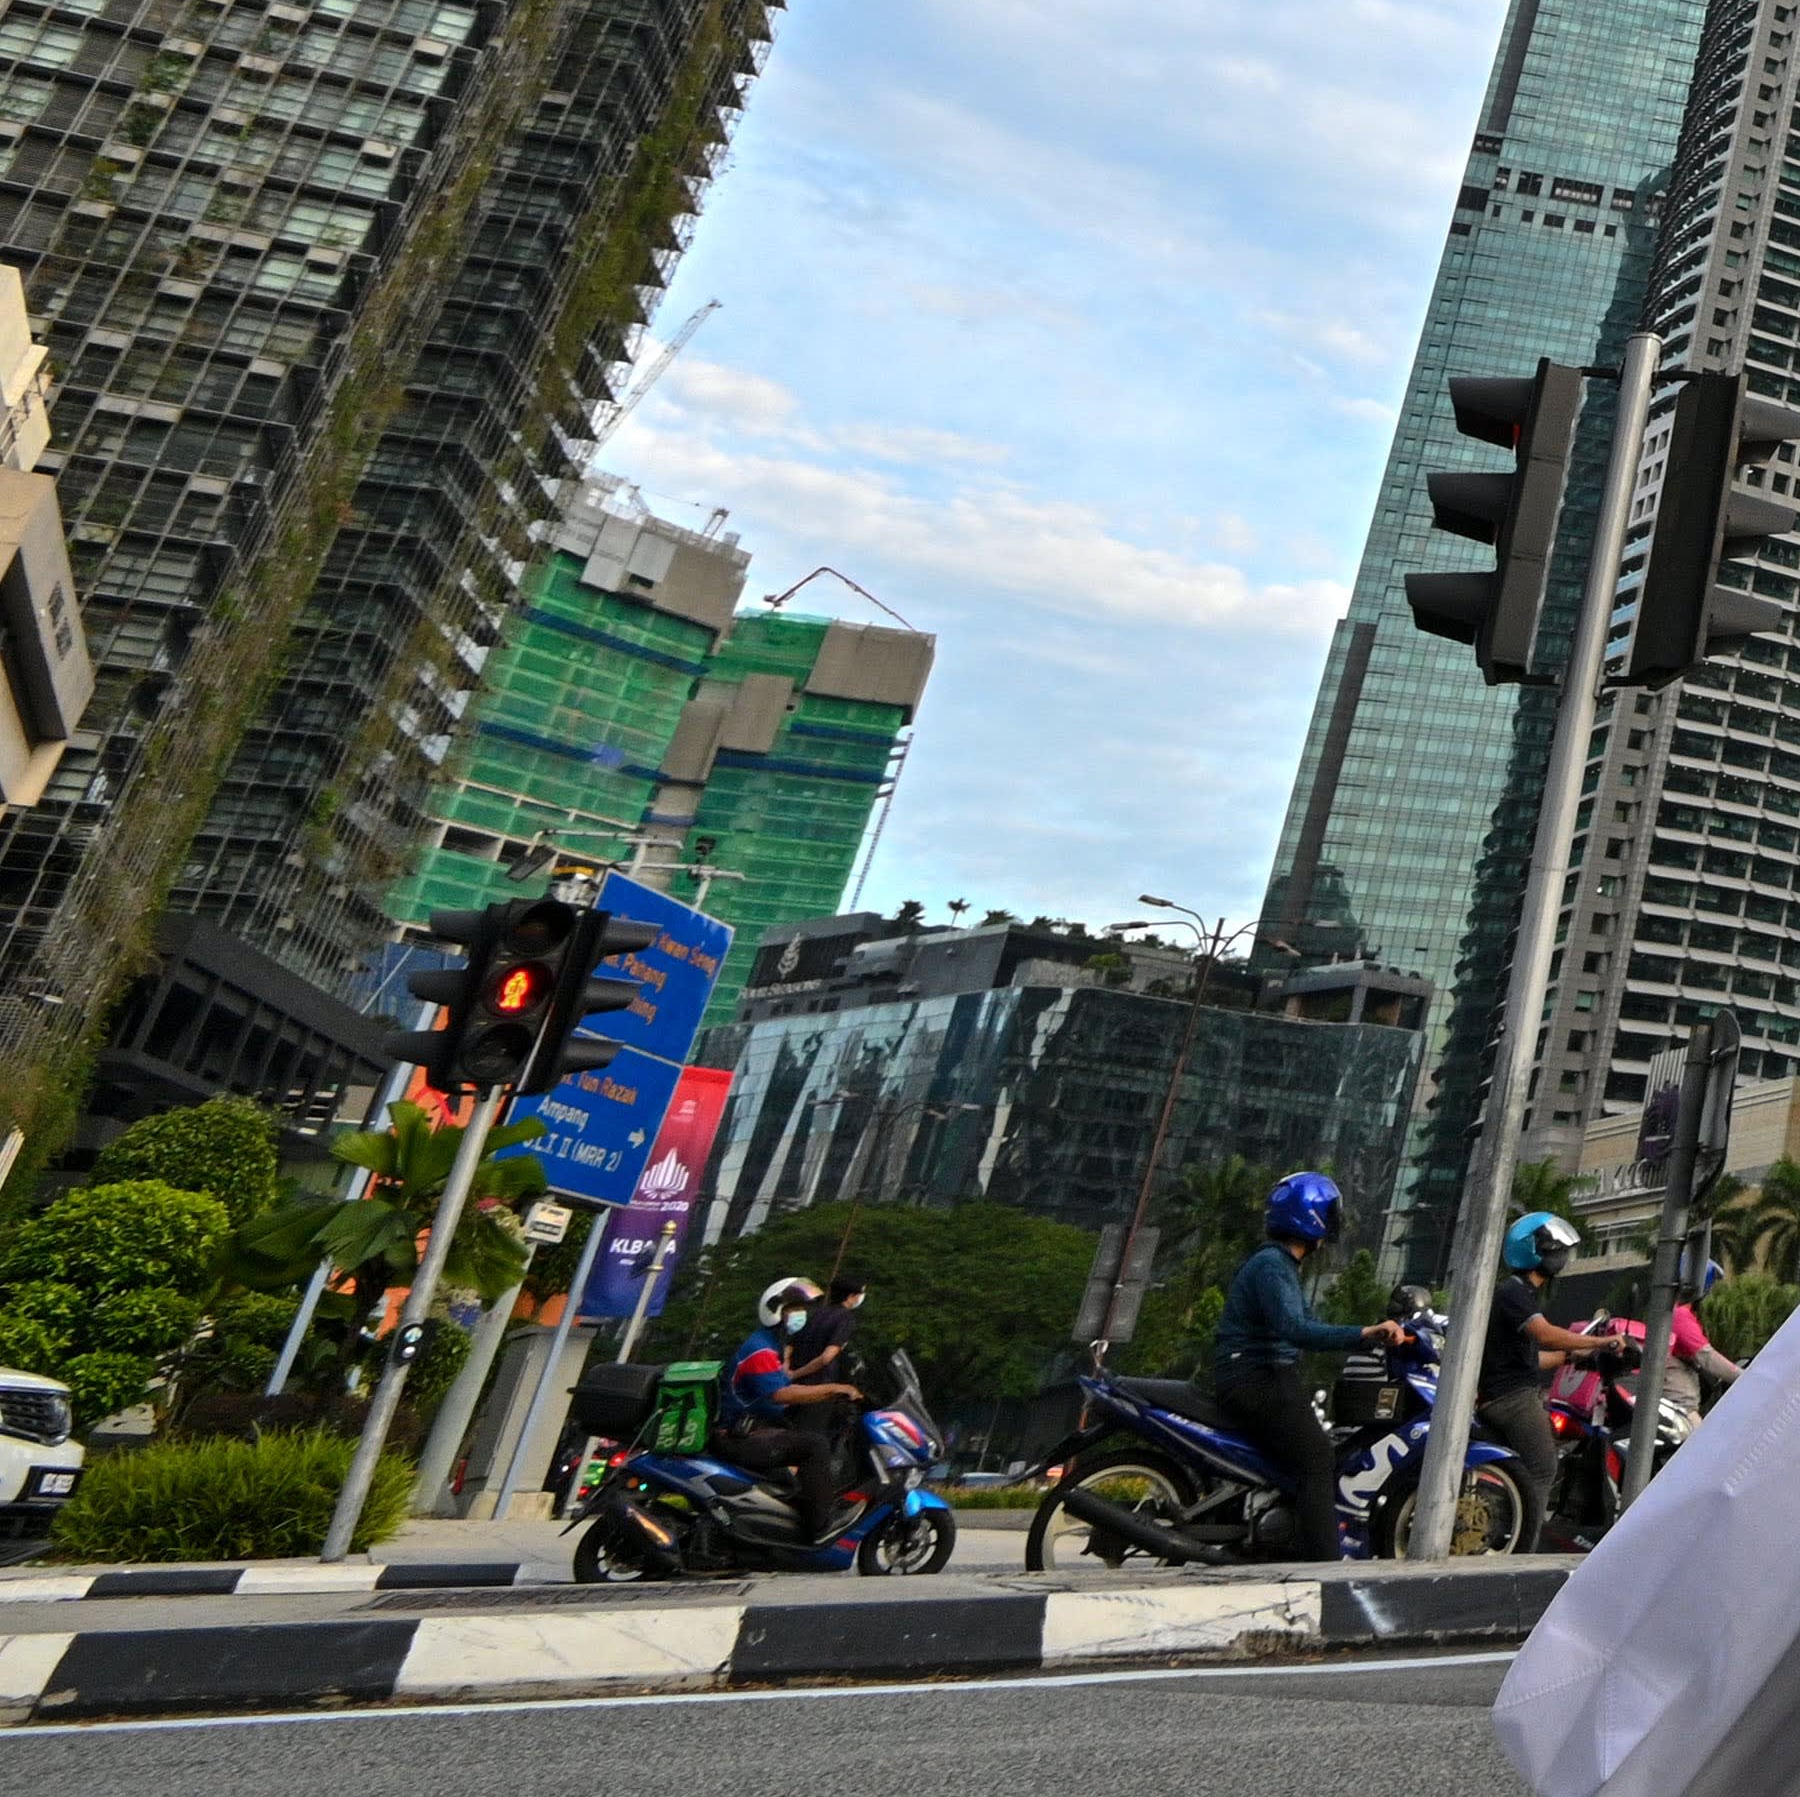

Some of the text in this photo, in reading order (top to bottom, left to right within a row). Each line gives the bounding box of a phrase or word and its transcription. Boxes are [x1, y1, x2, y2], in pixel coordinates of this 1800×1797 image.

[622, 953, 667, 993] Pahang
[689, 946, 717, 978] Seng
[578, 1071, 600, 1093] Tun
[601, 1076, 637, 1106] Razak
[537, 1095, 590, 1132] Ampang
[571, 1138, 607, 1168] (MRR
[605, 1150, 624, 1172] 2)
[660, 1201, 689, 1212] 2020
[609, 1238, 676, 1255] KLBA
